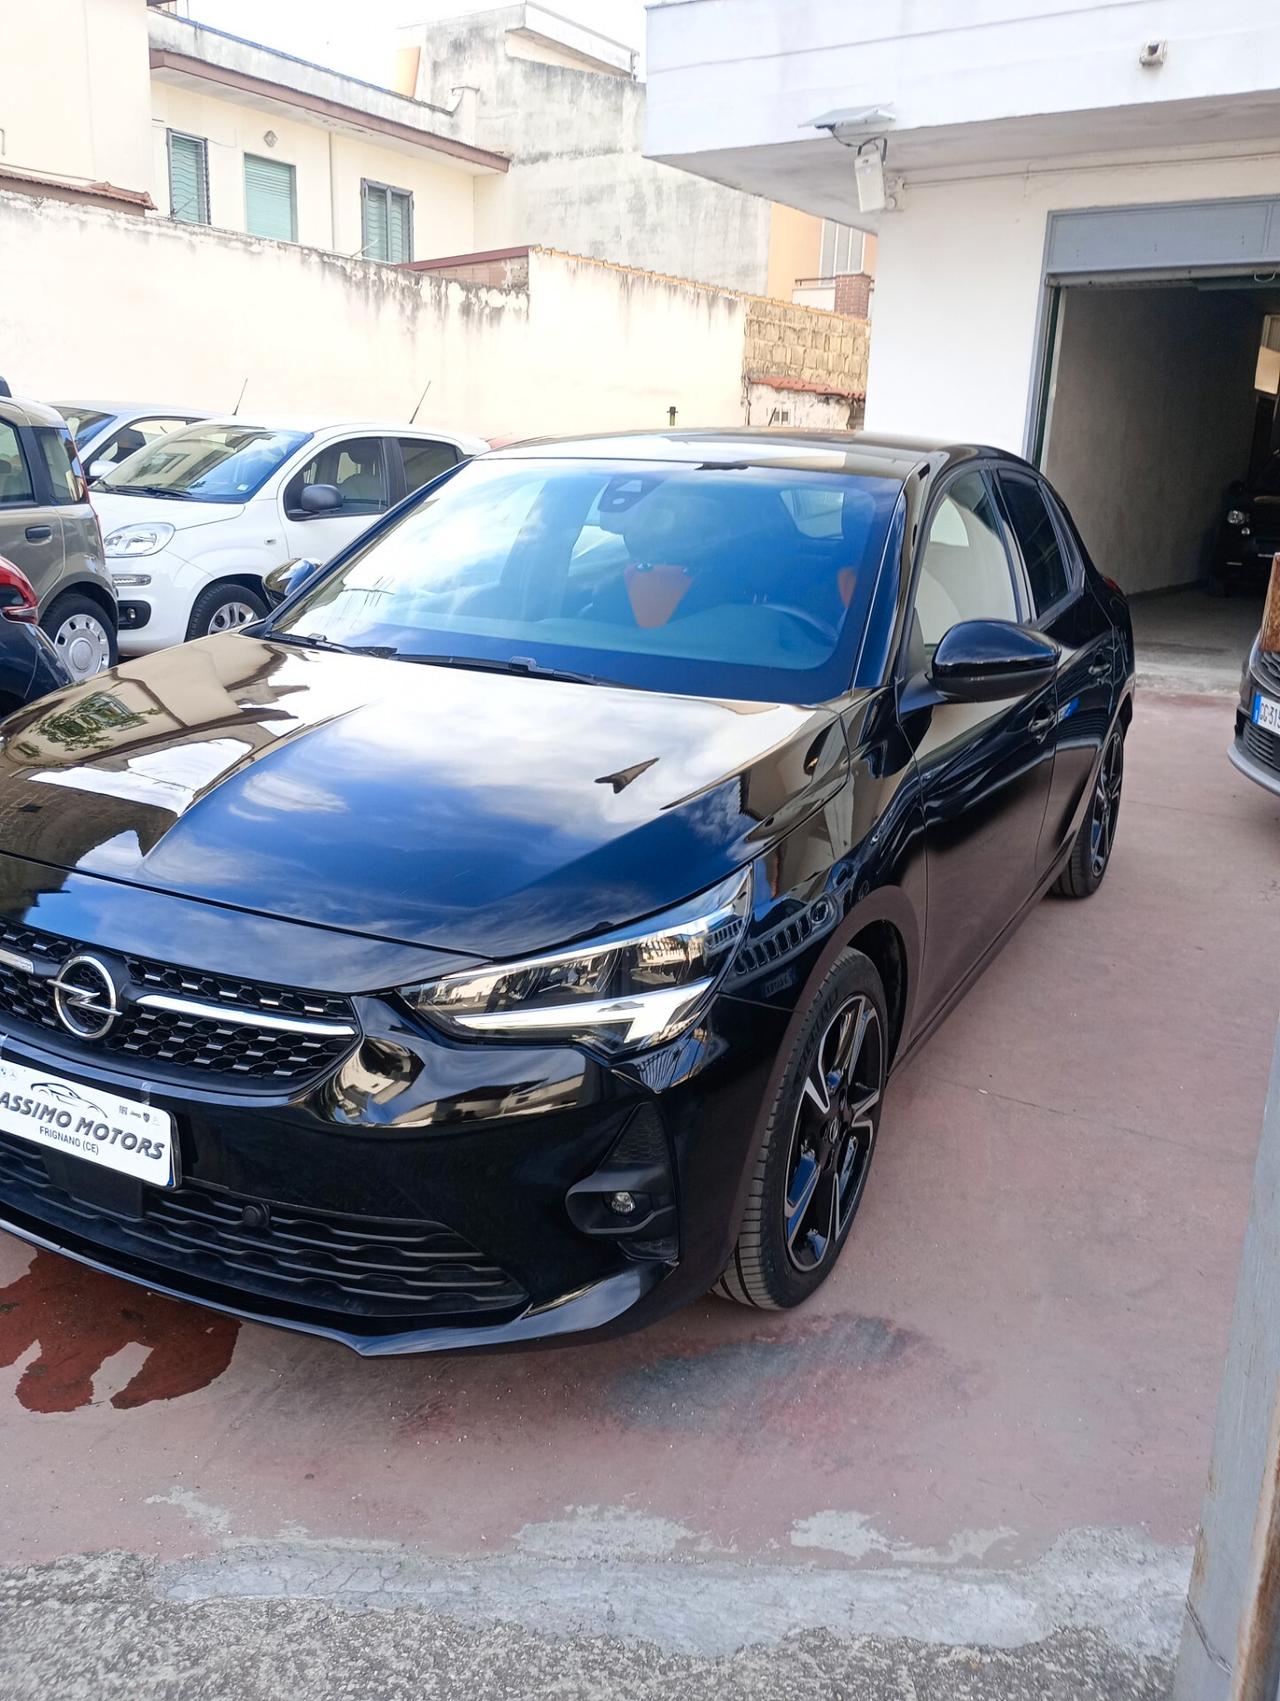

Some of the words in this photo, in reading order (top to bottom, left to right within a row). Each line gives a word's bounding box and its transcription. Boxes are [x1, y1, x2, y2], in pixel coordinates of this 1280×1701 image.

[39, 1126, 81, 1148] FRIGNANO
[83, 1140, 99, 1156] (CE)
[75, 1117, 165, 1159] MOTORS
